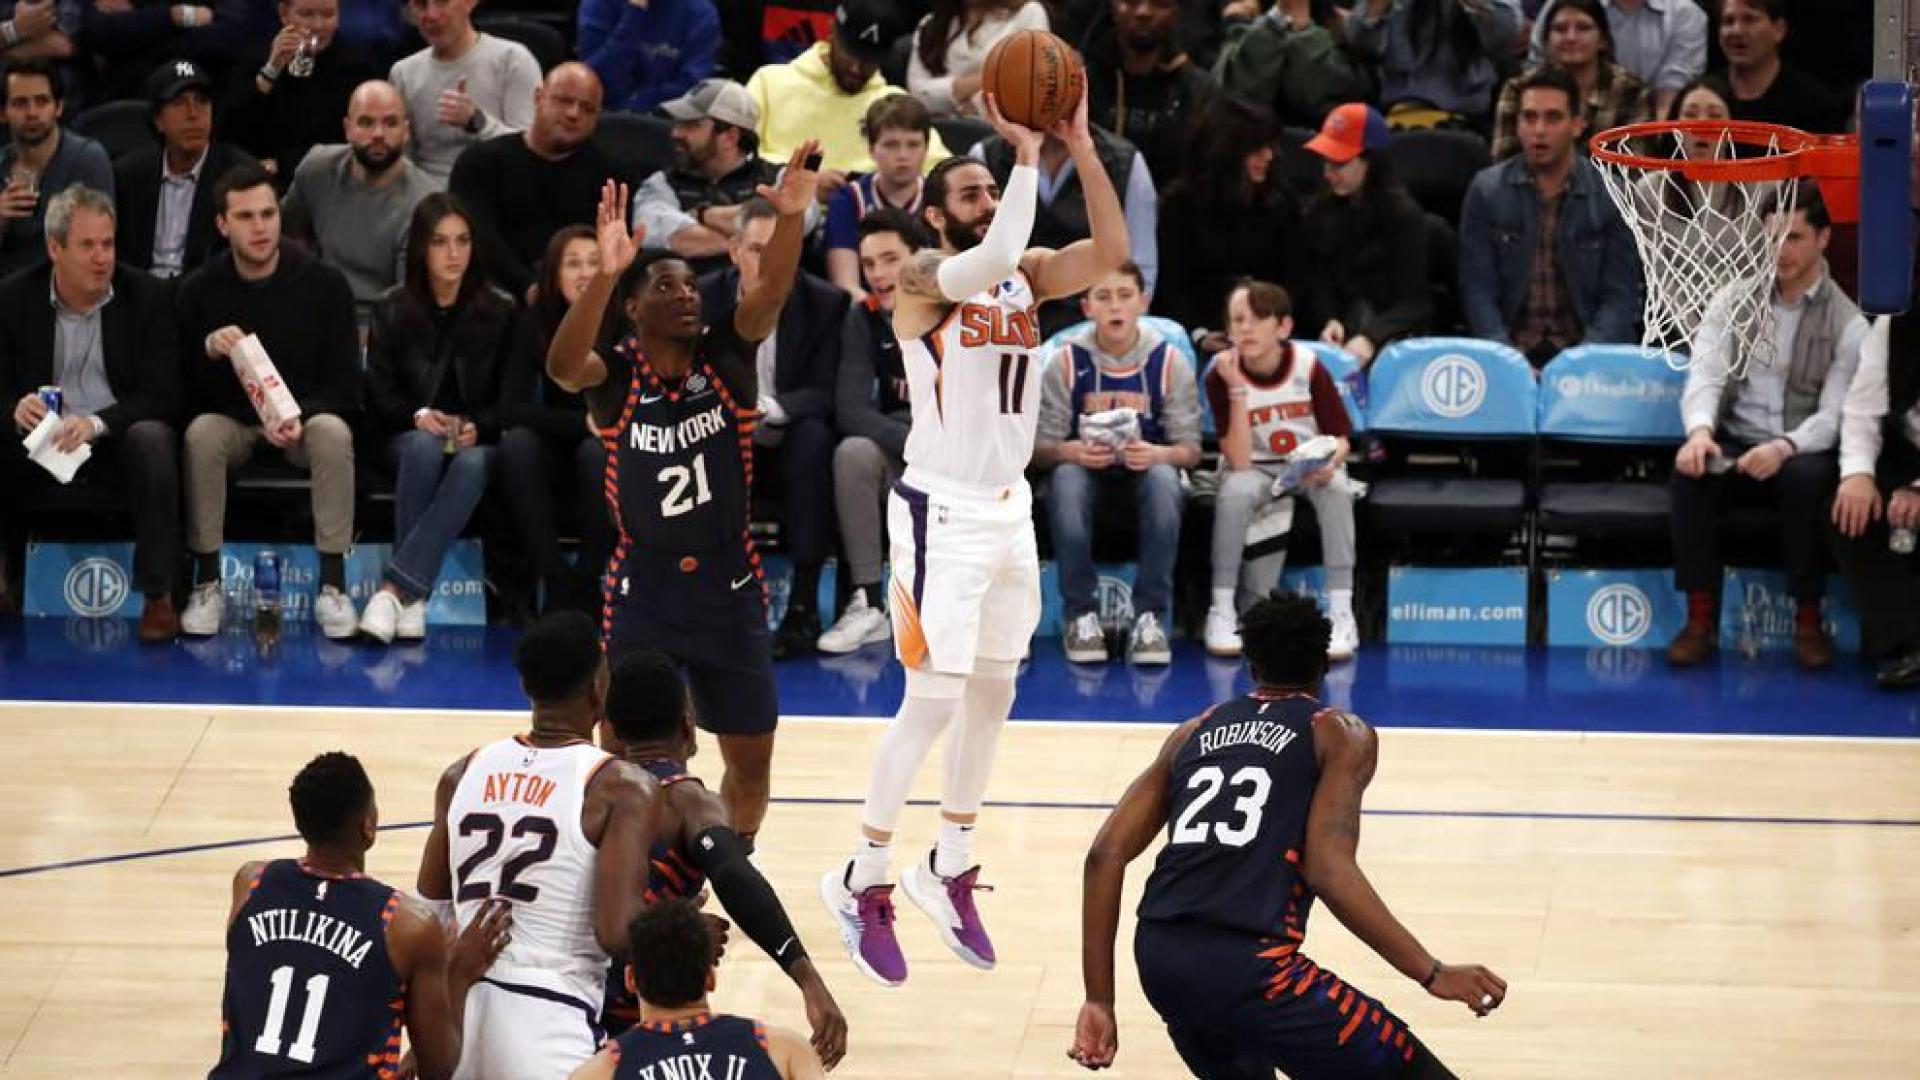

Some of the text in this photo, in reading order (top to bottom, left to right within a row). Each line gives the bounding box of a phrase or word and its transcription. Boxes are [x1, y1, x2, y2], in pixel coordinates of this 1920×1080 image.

[998, 352, 1029, 414] 11
[629, 404, 727, 454] NEW YORK
[656, 452, 713, 518] 21
[1390, 603, 1523, 622] elliman.com
[1199, 720, 1299, 756] ROBINSON
[483, 772, 557, 807] AYTON
[1172, 765, 1273, 848] 23
[456, 812, 559, 904] 22
[248, 908, 374, 970] NTILIKINA
[255, 965, 330, 1064] 11
